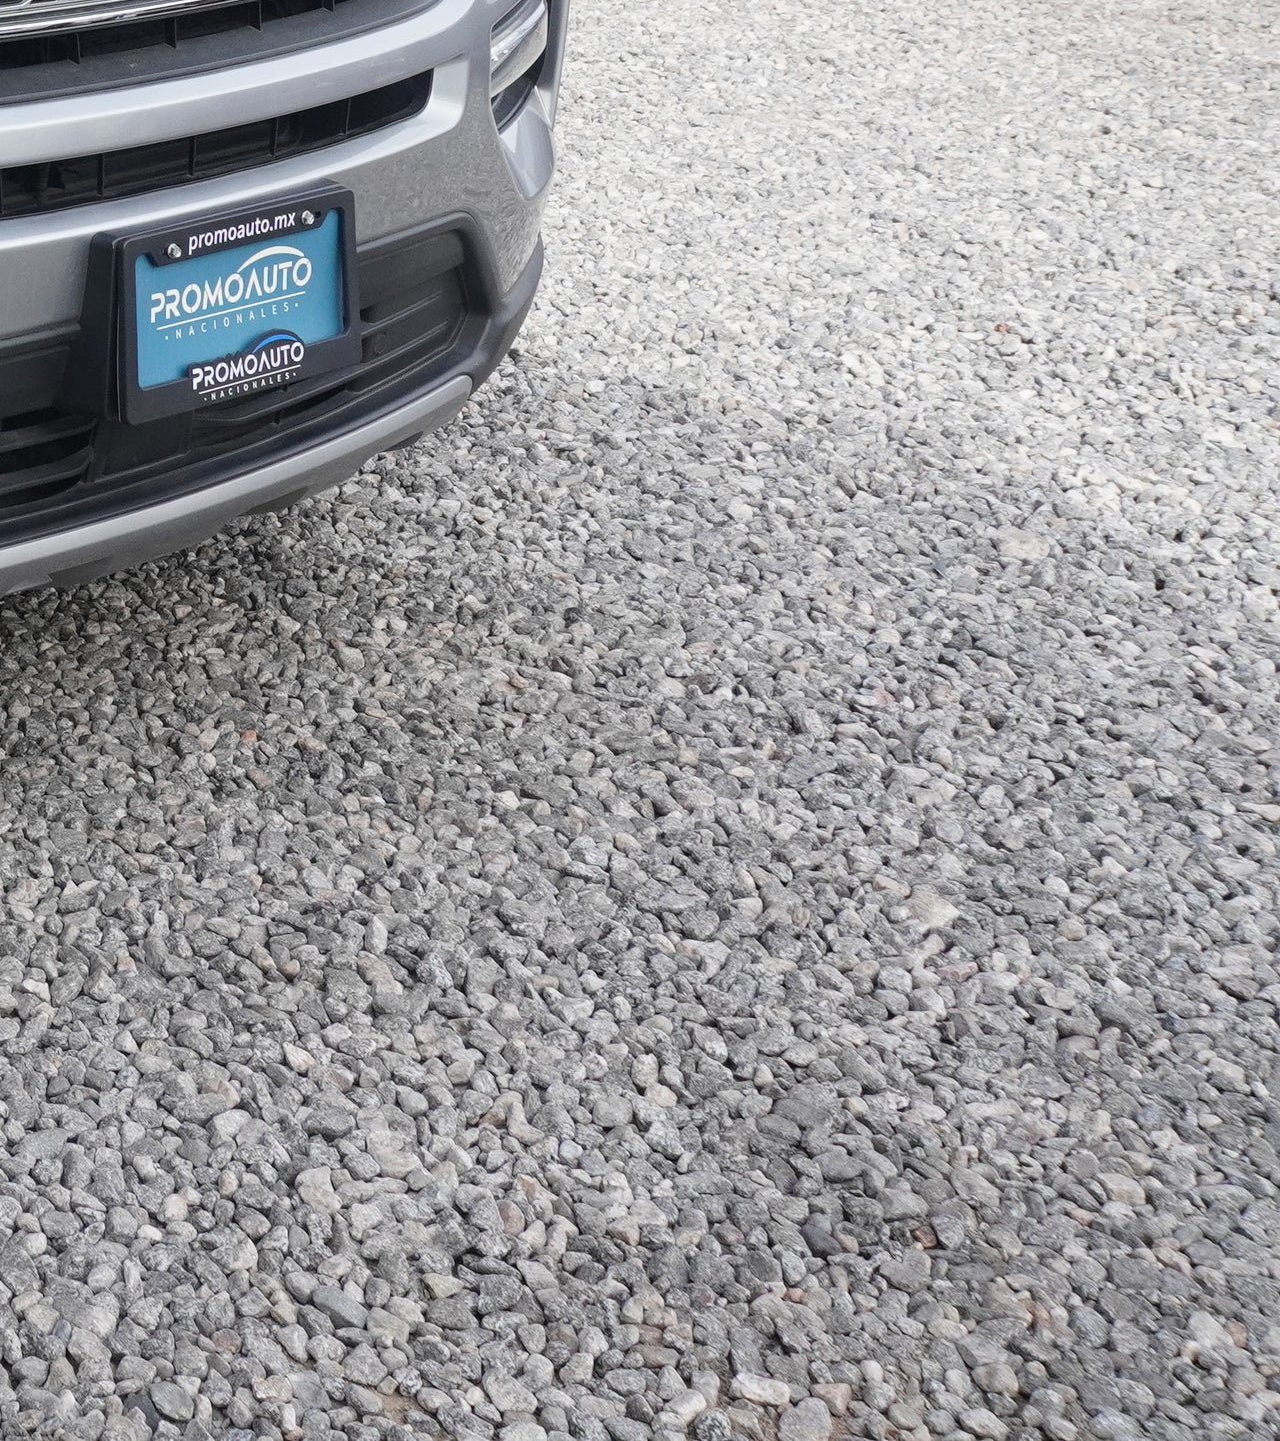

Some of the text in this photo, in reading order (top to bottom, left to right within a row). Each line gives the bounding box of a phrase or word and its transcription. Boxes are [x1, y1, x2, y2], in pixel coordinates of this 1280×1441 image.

[188, 211, 296, 256] promoauto.mx
[150, 256, 313, 324] PROMOAUTO
[174, 302, 290, 341] NACIONALES
[192, 341, 305, 391] PROMOAUTO
[210, 371, 291, 401] NACIONALES
